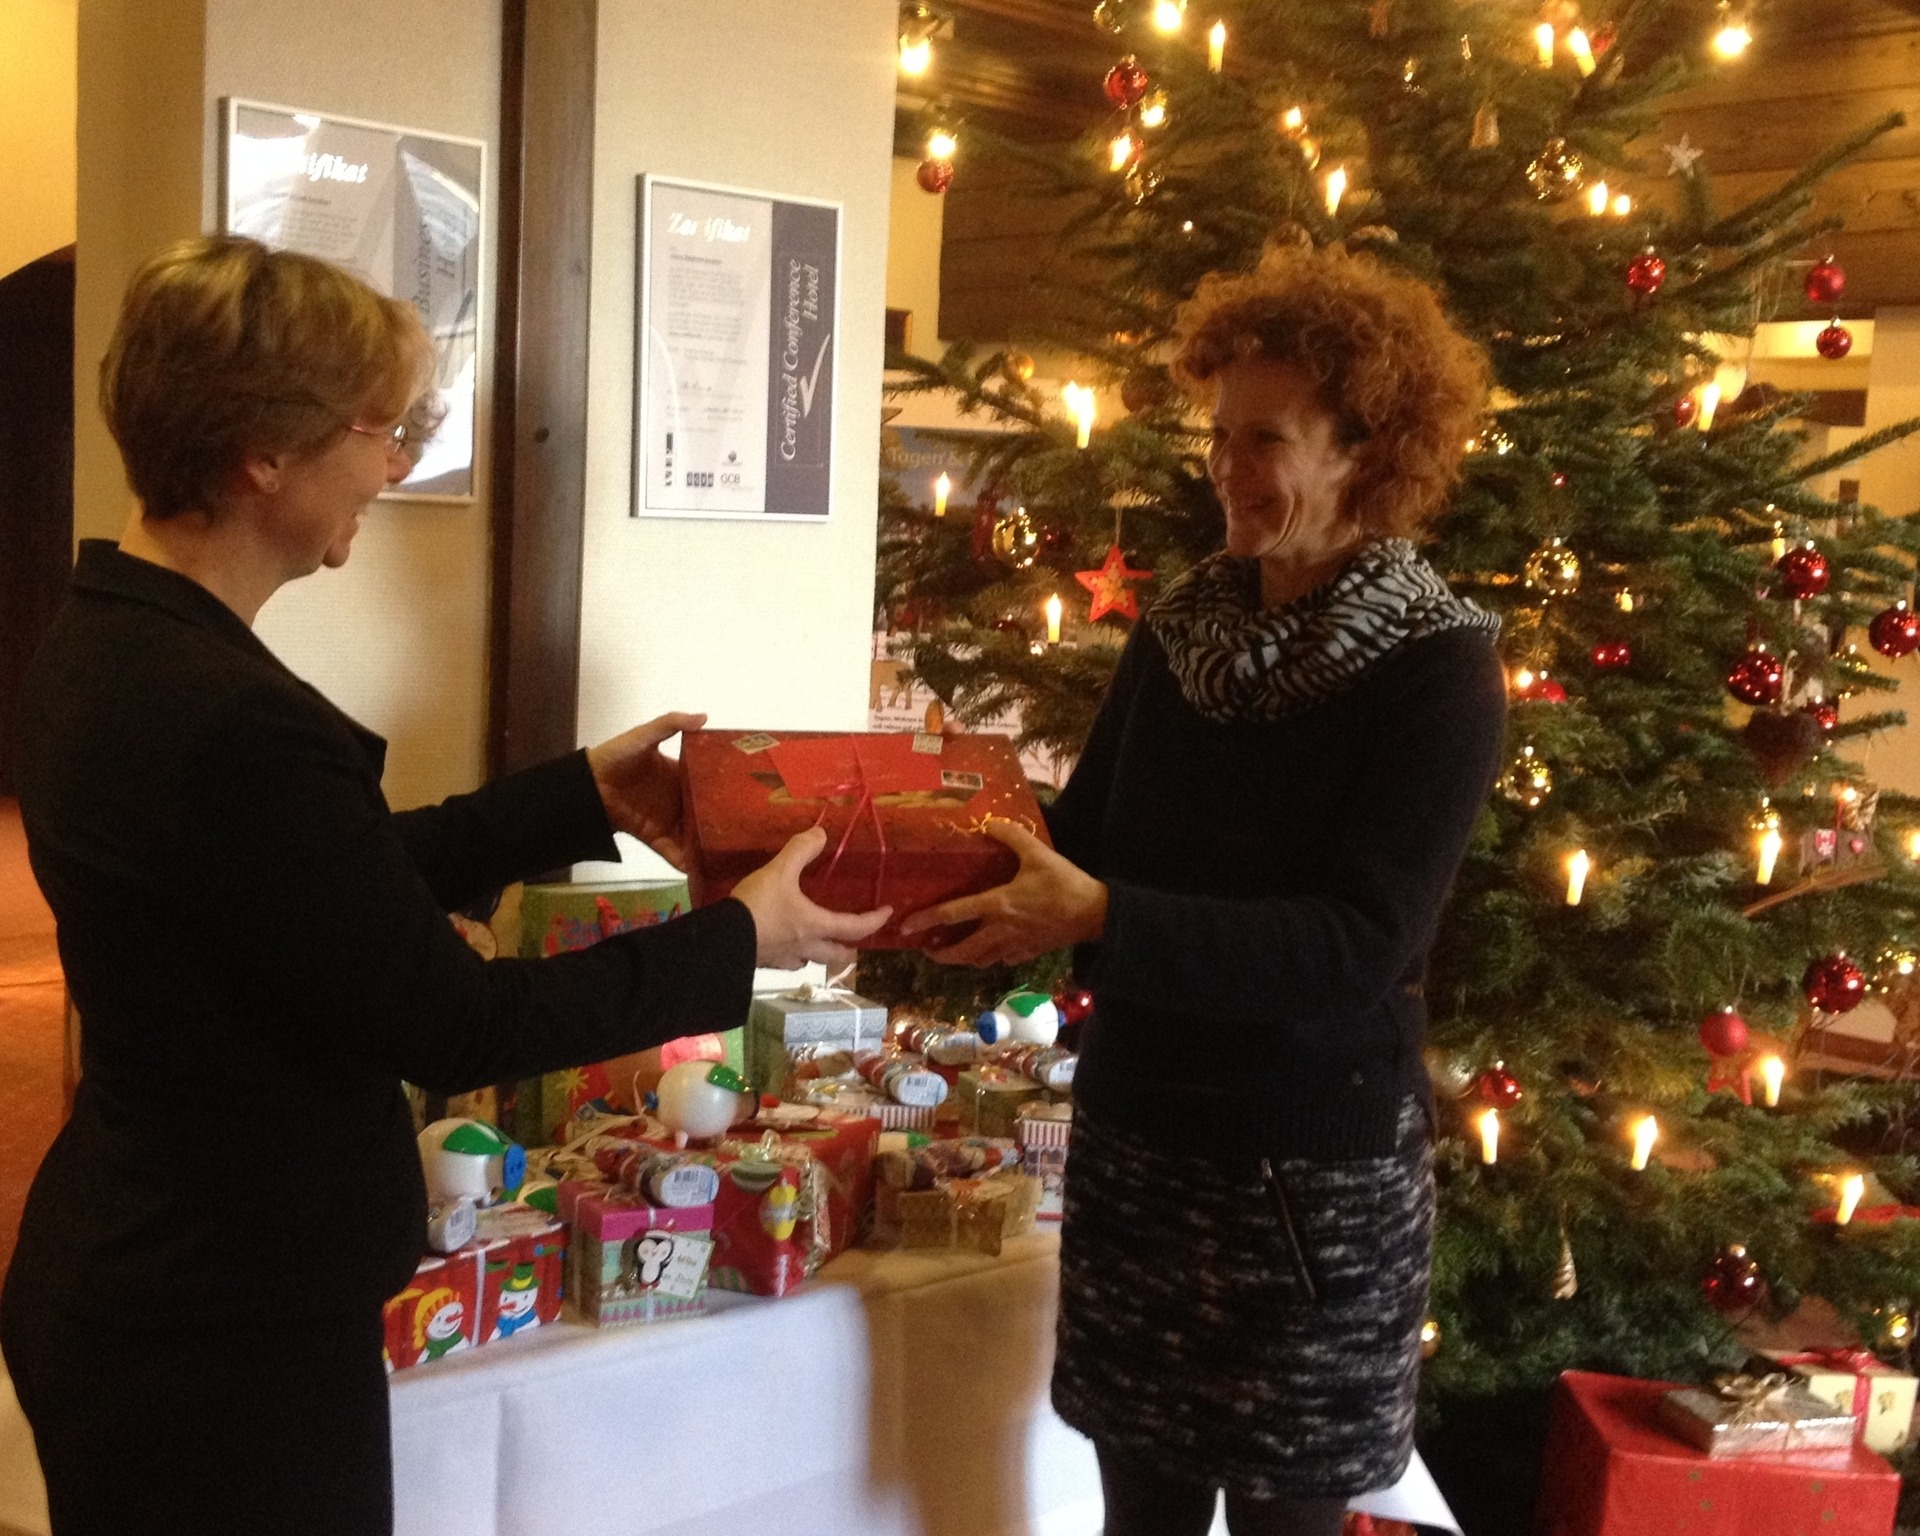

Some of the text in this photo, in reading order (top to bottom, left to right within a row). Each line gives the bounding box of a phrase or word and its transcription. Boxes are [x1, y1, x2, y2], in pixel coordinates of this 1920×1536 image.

[803, 264, 820, 321] Hotel
[779, 259, 803, 462] Certified Conference
